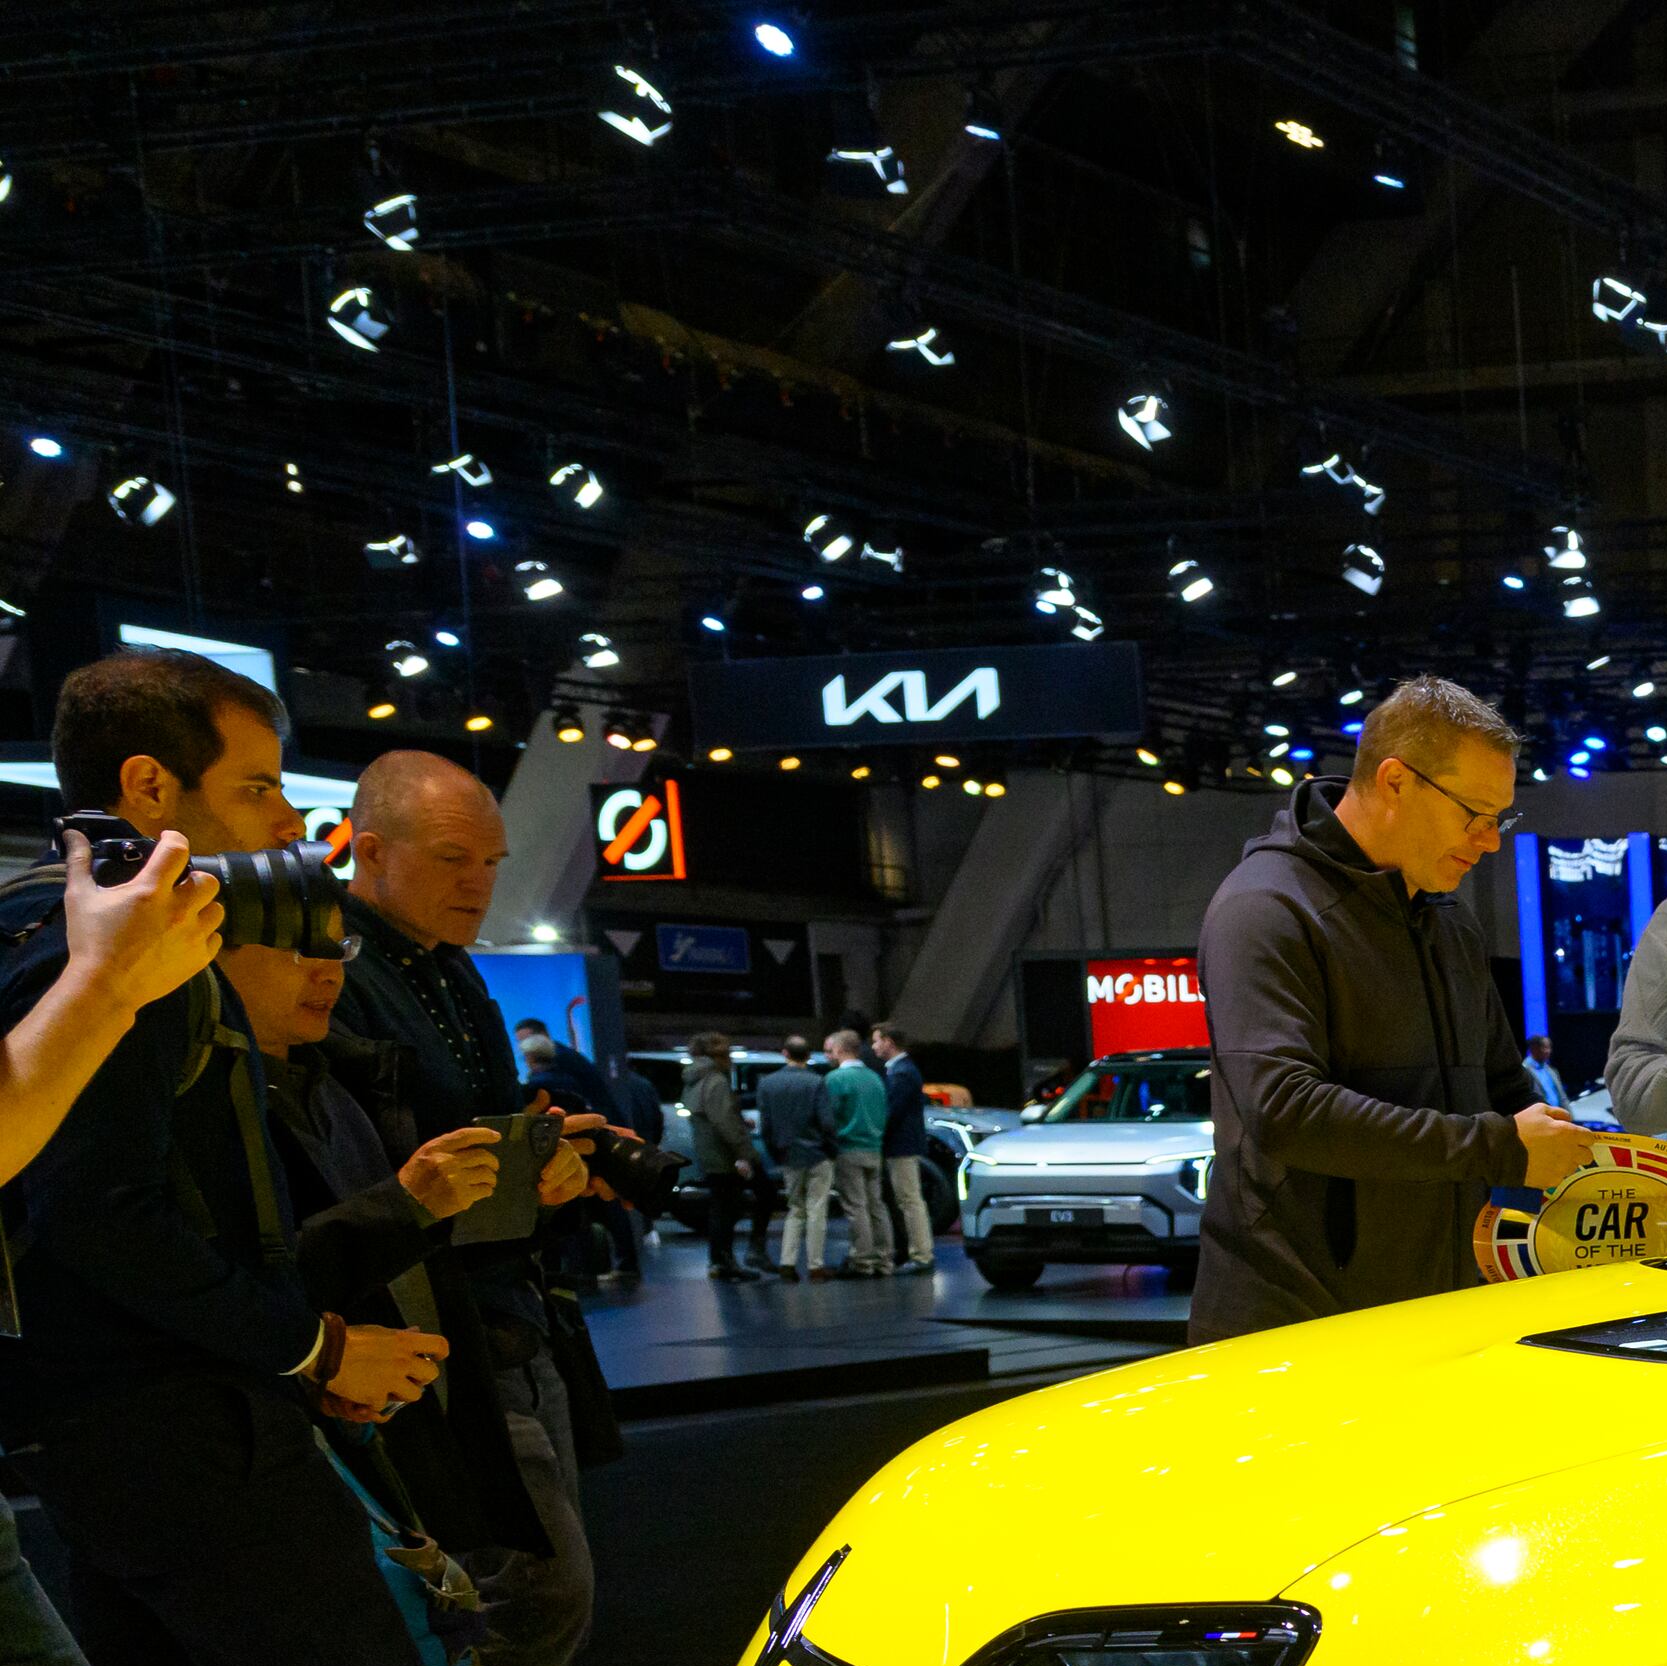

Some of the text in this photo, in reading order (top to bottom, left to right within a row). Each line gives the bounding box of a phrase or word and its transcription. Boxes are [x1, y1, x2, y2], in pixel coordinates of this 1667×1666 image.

[822, 667, 1000, 726] KIA
[1087, 973, 1206, 1005] MOBIL
[1598, 1188, 1636, 1200] THE
[1575, 1202, 1649, 1241] CAR
[1574, 1243, 1647, 1259] OF THE
